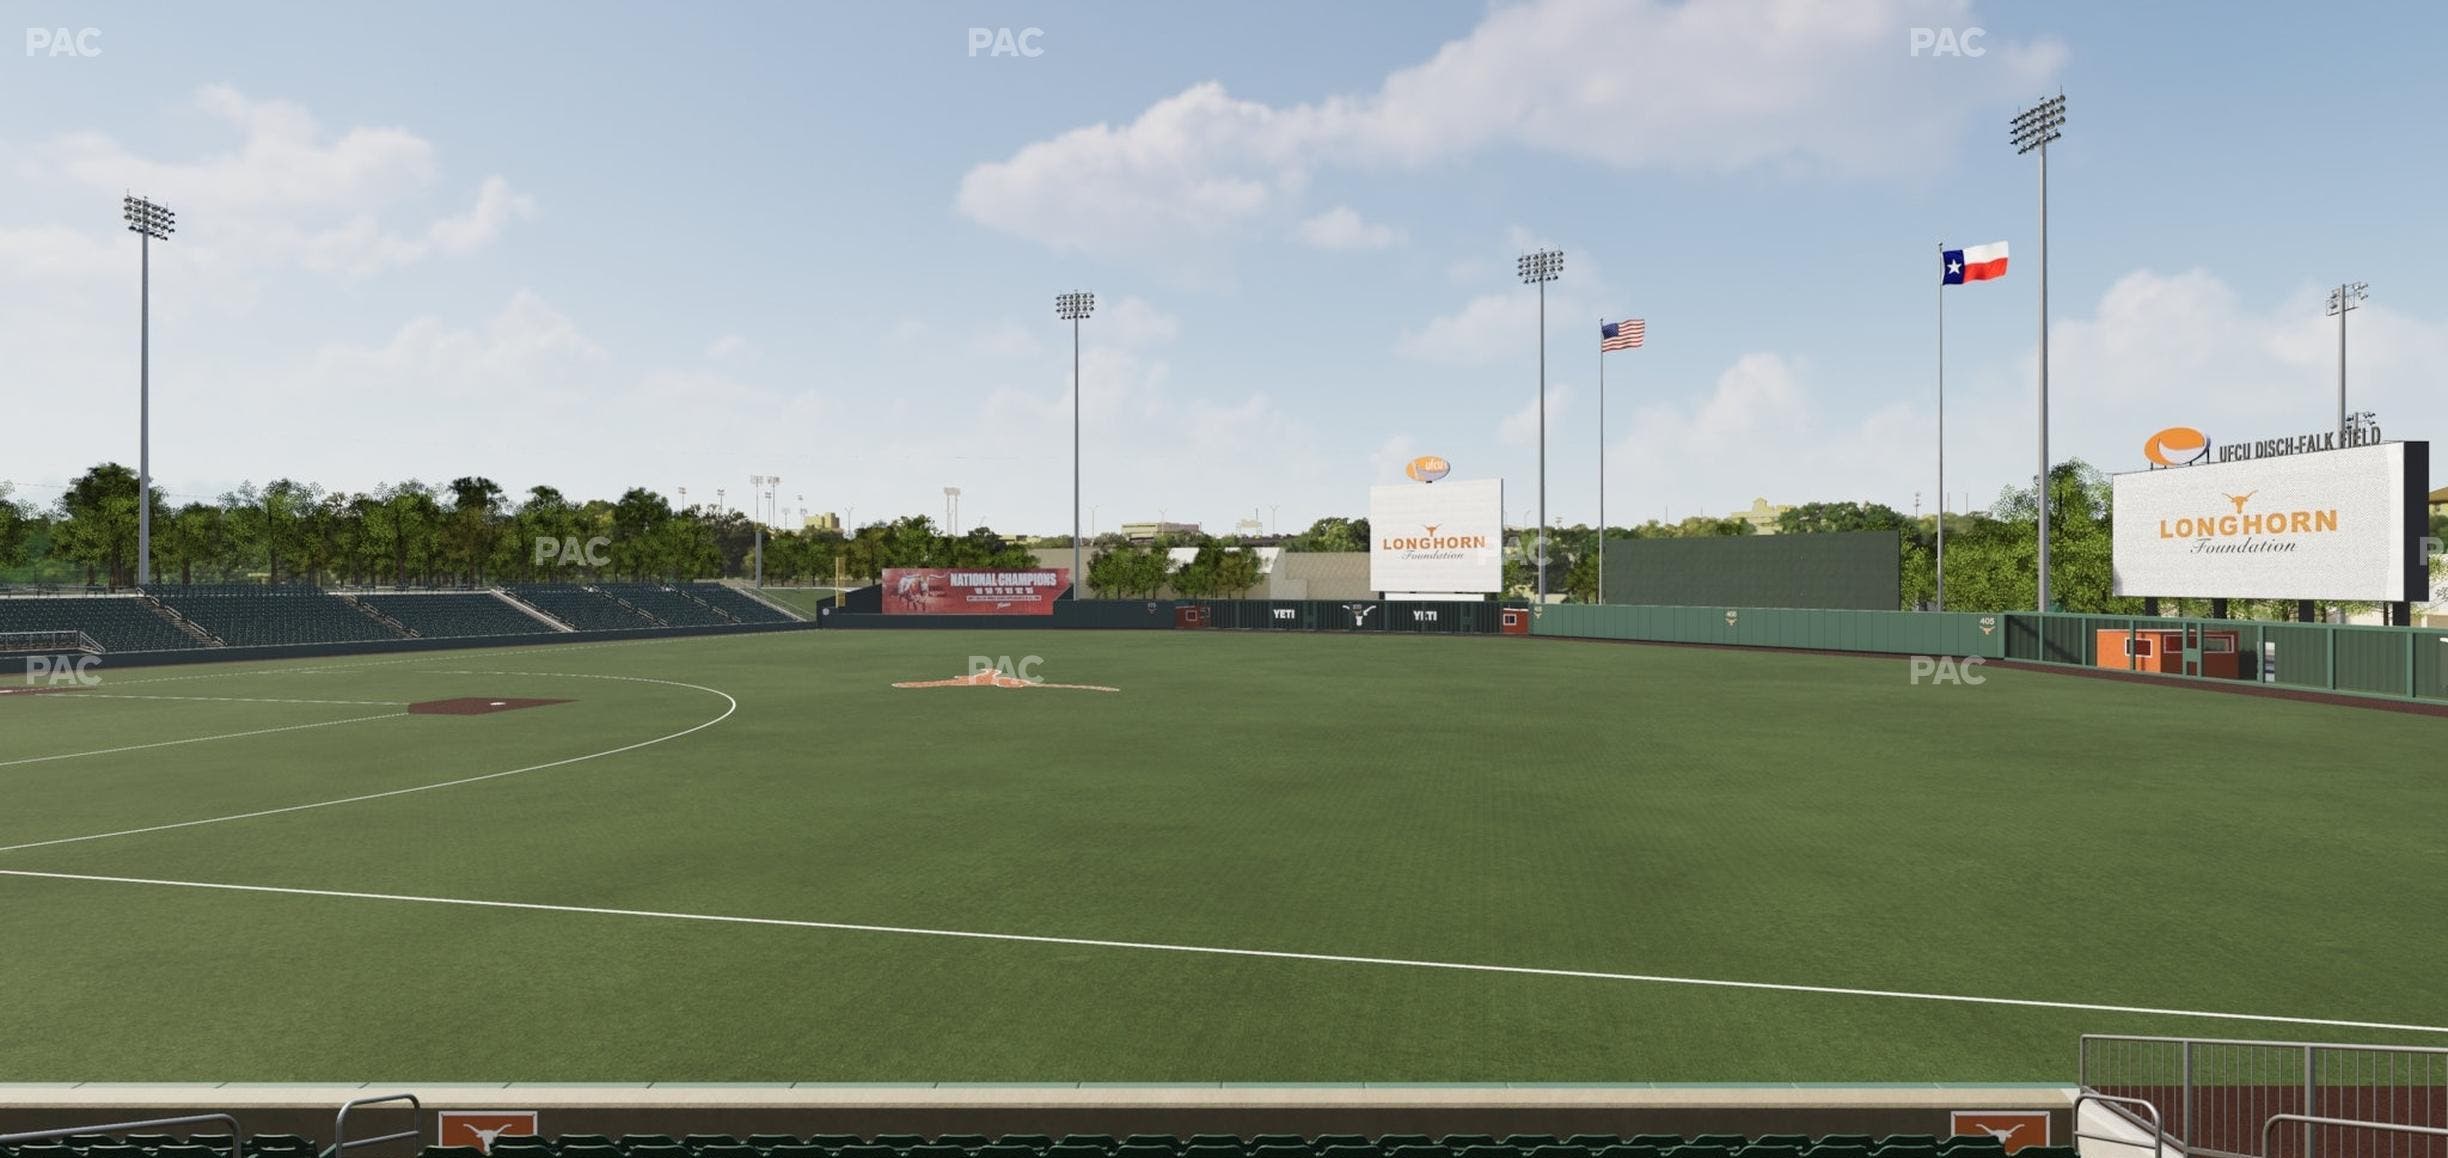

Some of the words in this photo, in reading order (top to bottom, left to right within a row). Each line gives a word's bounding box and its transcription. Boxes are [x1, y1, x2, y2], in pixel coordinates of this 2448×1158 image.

[2219, 442, 2251, 463] UFCU
[2255, 431, 2334, 459] DISCH-FALK
[2339, 426, 2381, 449] FIELD
[2160, 509, 2339, 539] LONGHORN
[1383, 535, 1486, 550] LONGHORN
[2190, 536, 2297, 555] Foundation
[1401, 549, 1465, 561] Foundation
[950, 573, 997, 587] NATIONAL
[998, 573, 1057, 587] CHAMPIONS
[1273, 609, 1295, 619] YETI
[1979, 617, 1995, 625] 405
